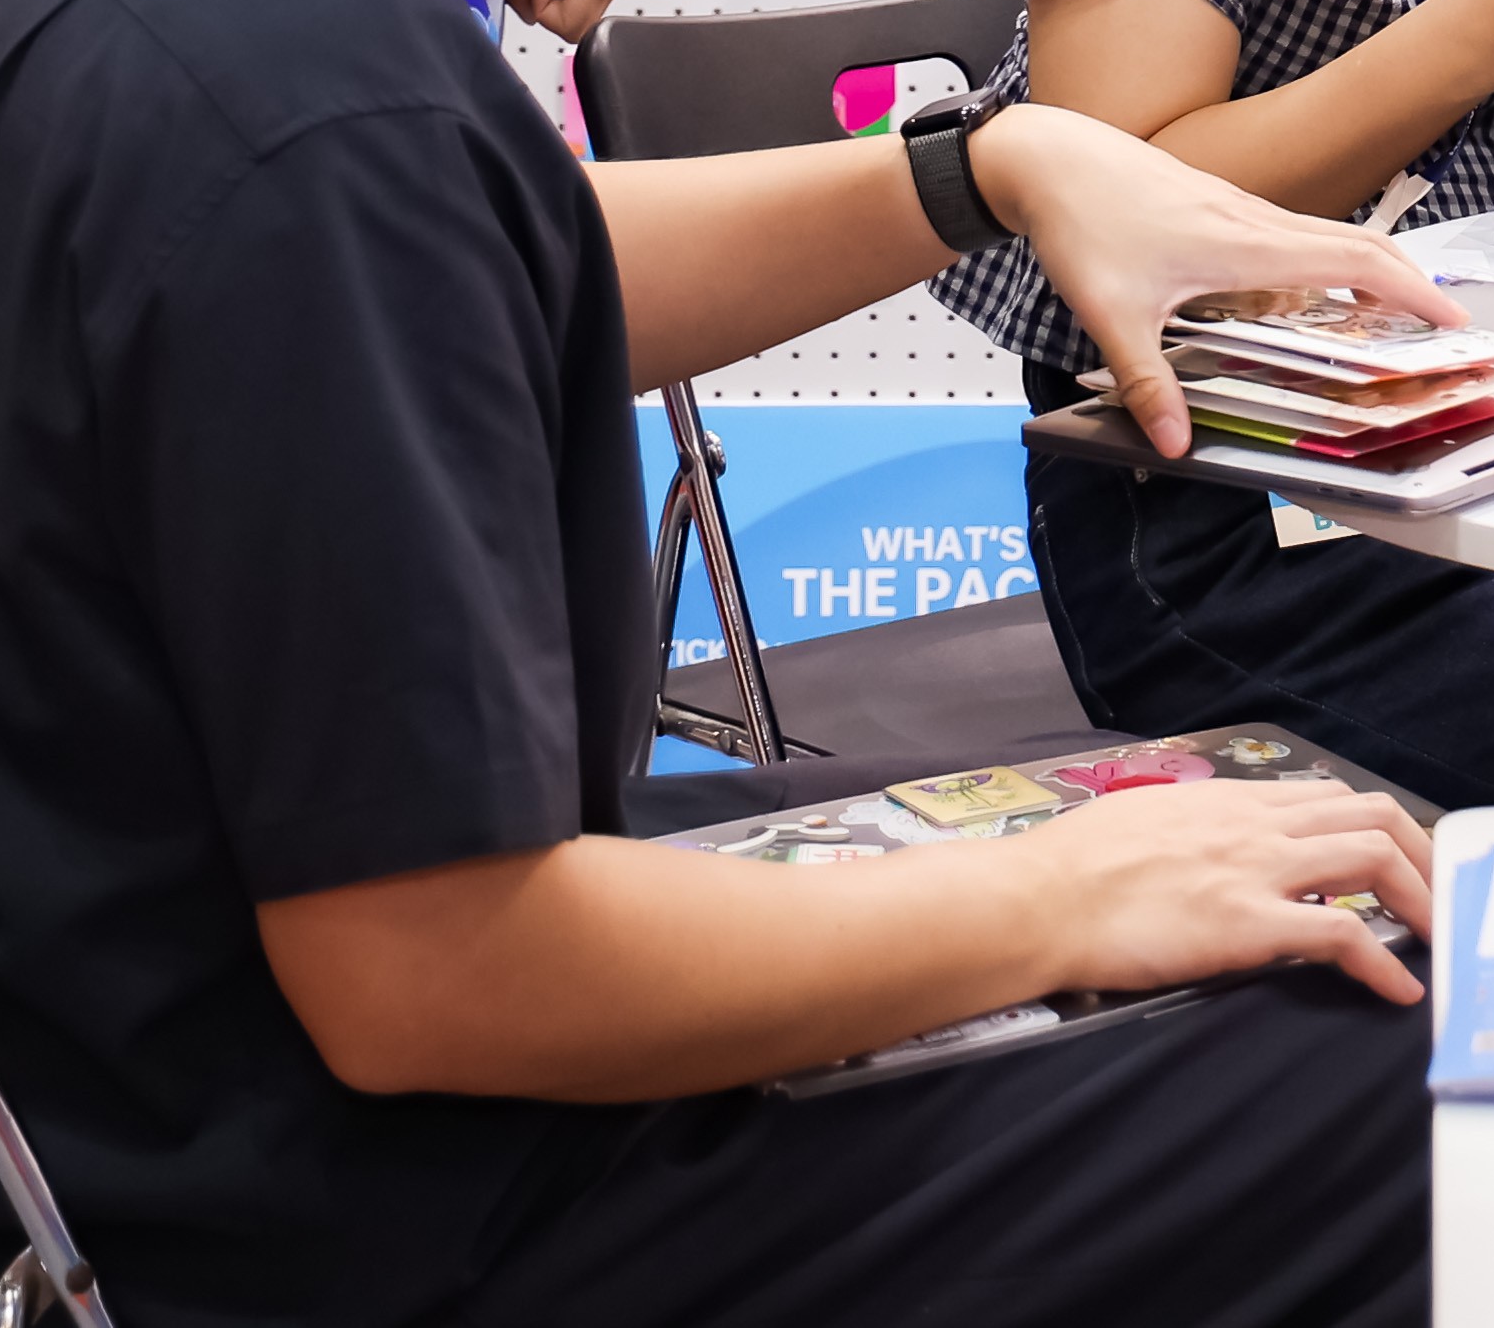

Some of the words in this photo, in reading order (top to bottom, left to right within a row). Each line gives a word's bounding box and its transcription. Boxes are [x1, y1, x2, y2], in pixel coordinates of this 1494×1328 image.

[861, 525, 1027, 563] WHAT'S
[781, 567, 898, 618] THE
[915, 566, 1036, 616] PAC
